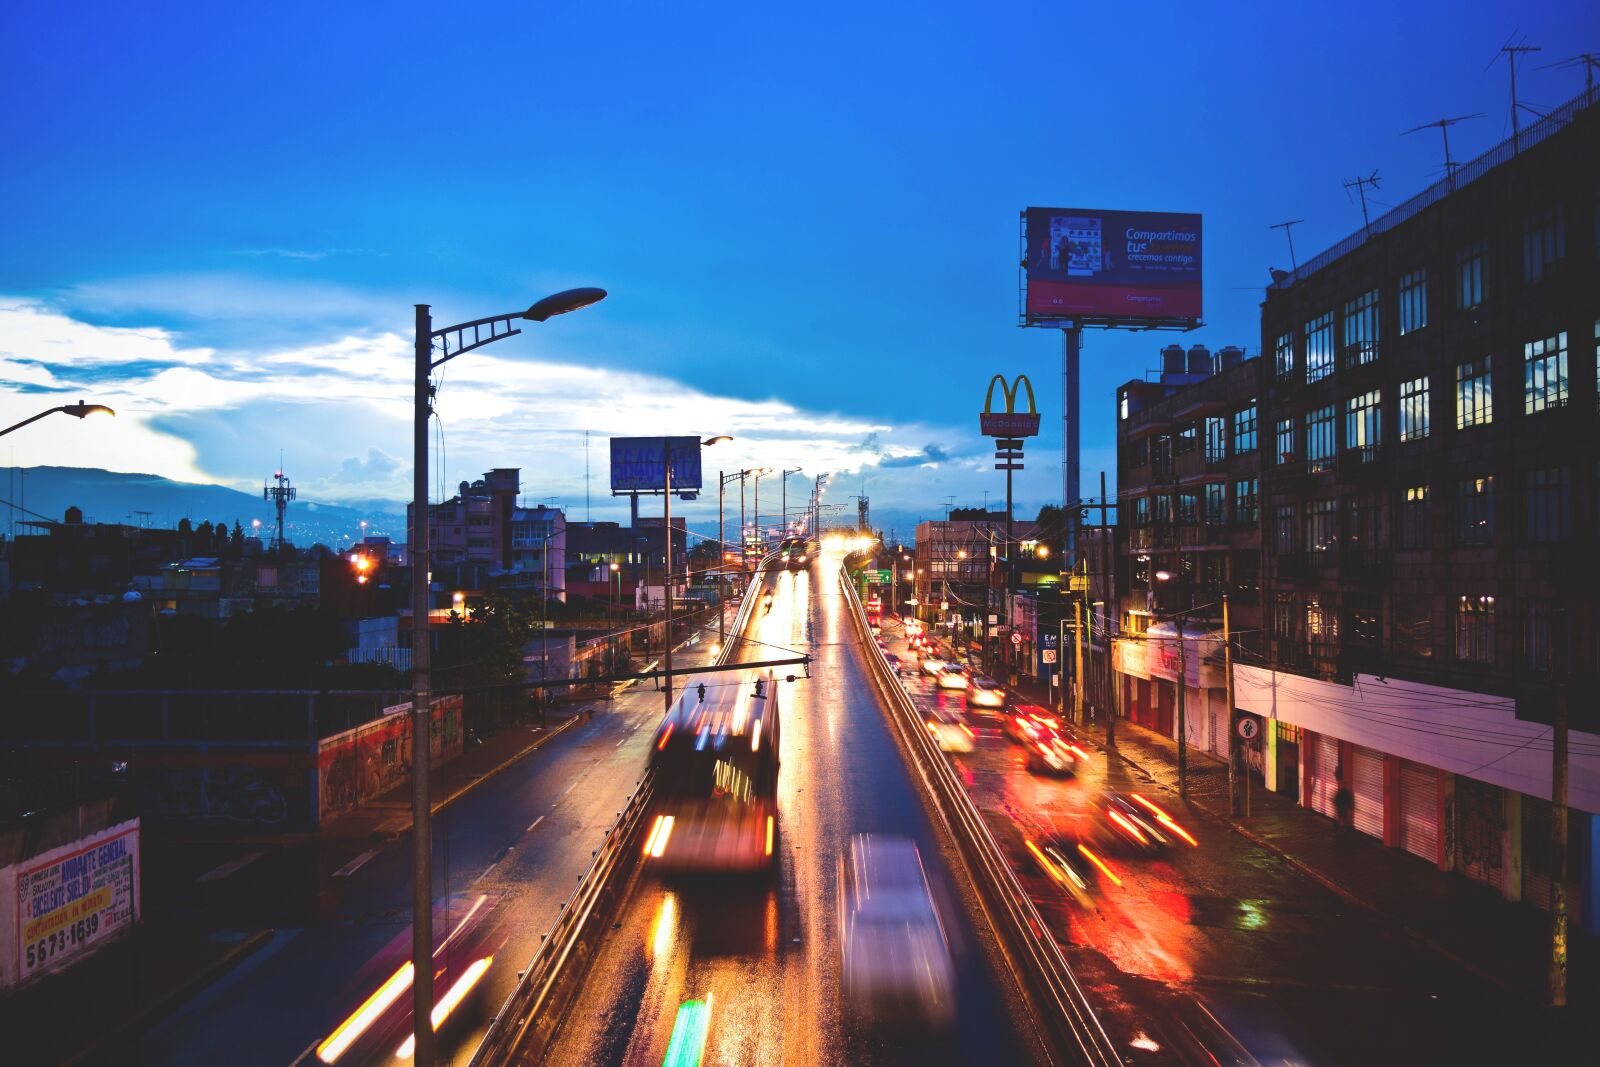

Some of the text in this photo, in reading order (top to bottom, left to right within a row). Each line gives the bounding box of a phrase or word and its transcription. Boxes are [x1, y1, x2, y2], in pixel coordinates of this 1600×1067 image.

[1126, 228, 1197, 244] Compartimos
[1127, 240, 1149, 254] tus
[1127, 254, 1163, 262] crecemos
[62, 849, 97, 884] AYUDANTE
[98, 836, 127, 867] GENERAL
[32, 879, 55, 896] SOLICITA
[33, 885, 66, 918] EXCELENTE
[66, 874, 89, 902] SUELDO
